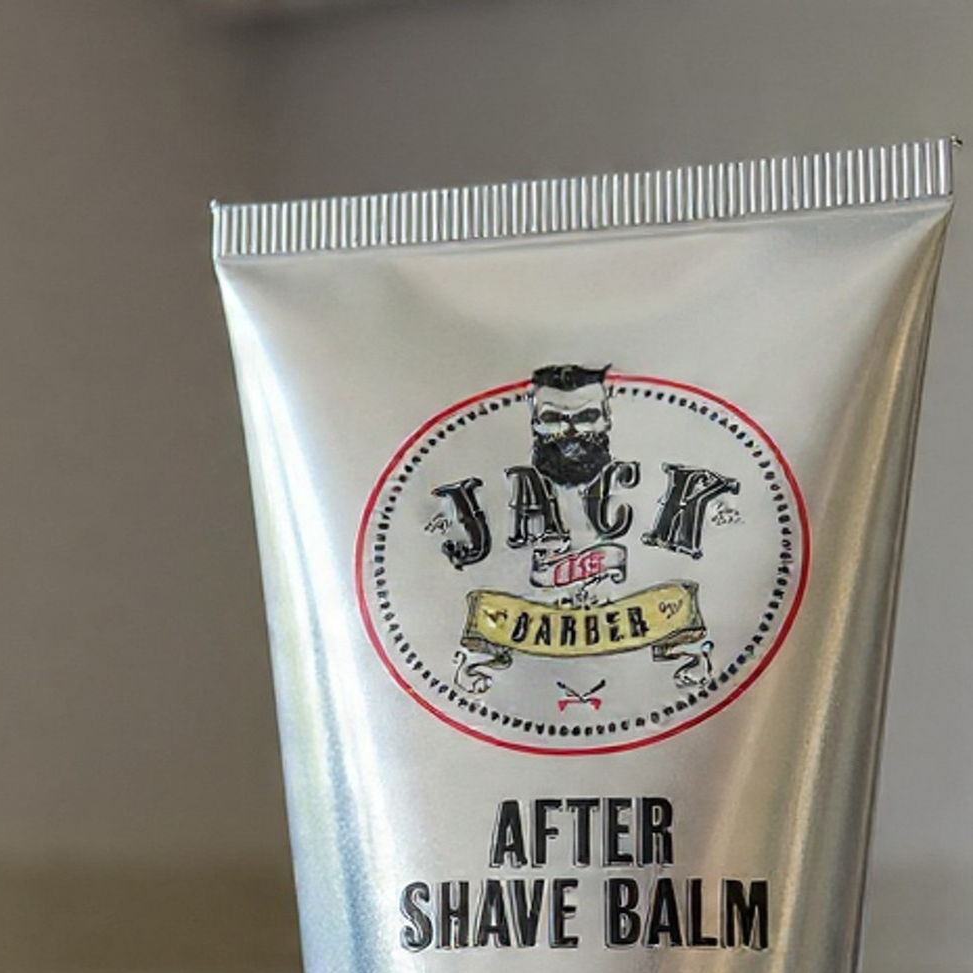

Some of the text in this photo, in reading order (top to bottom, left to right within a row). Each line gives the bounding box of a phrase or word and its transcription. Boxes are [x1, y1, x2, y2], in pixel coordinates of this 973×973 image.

[431, 460, 741, 572] JACK
[490, 796, 675, 868] AFTER
[400, 876, 769, 952] SHAVE BALM
